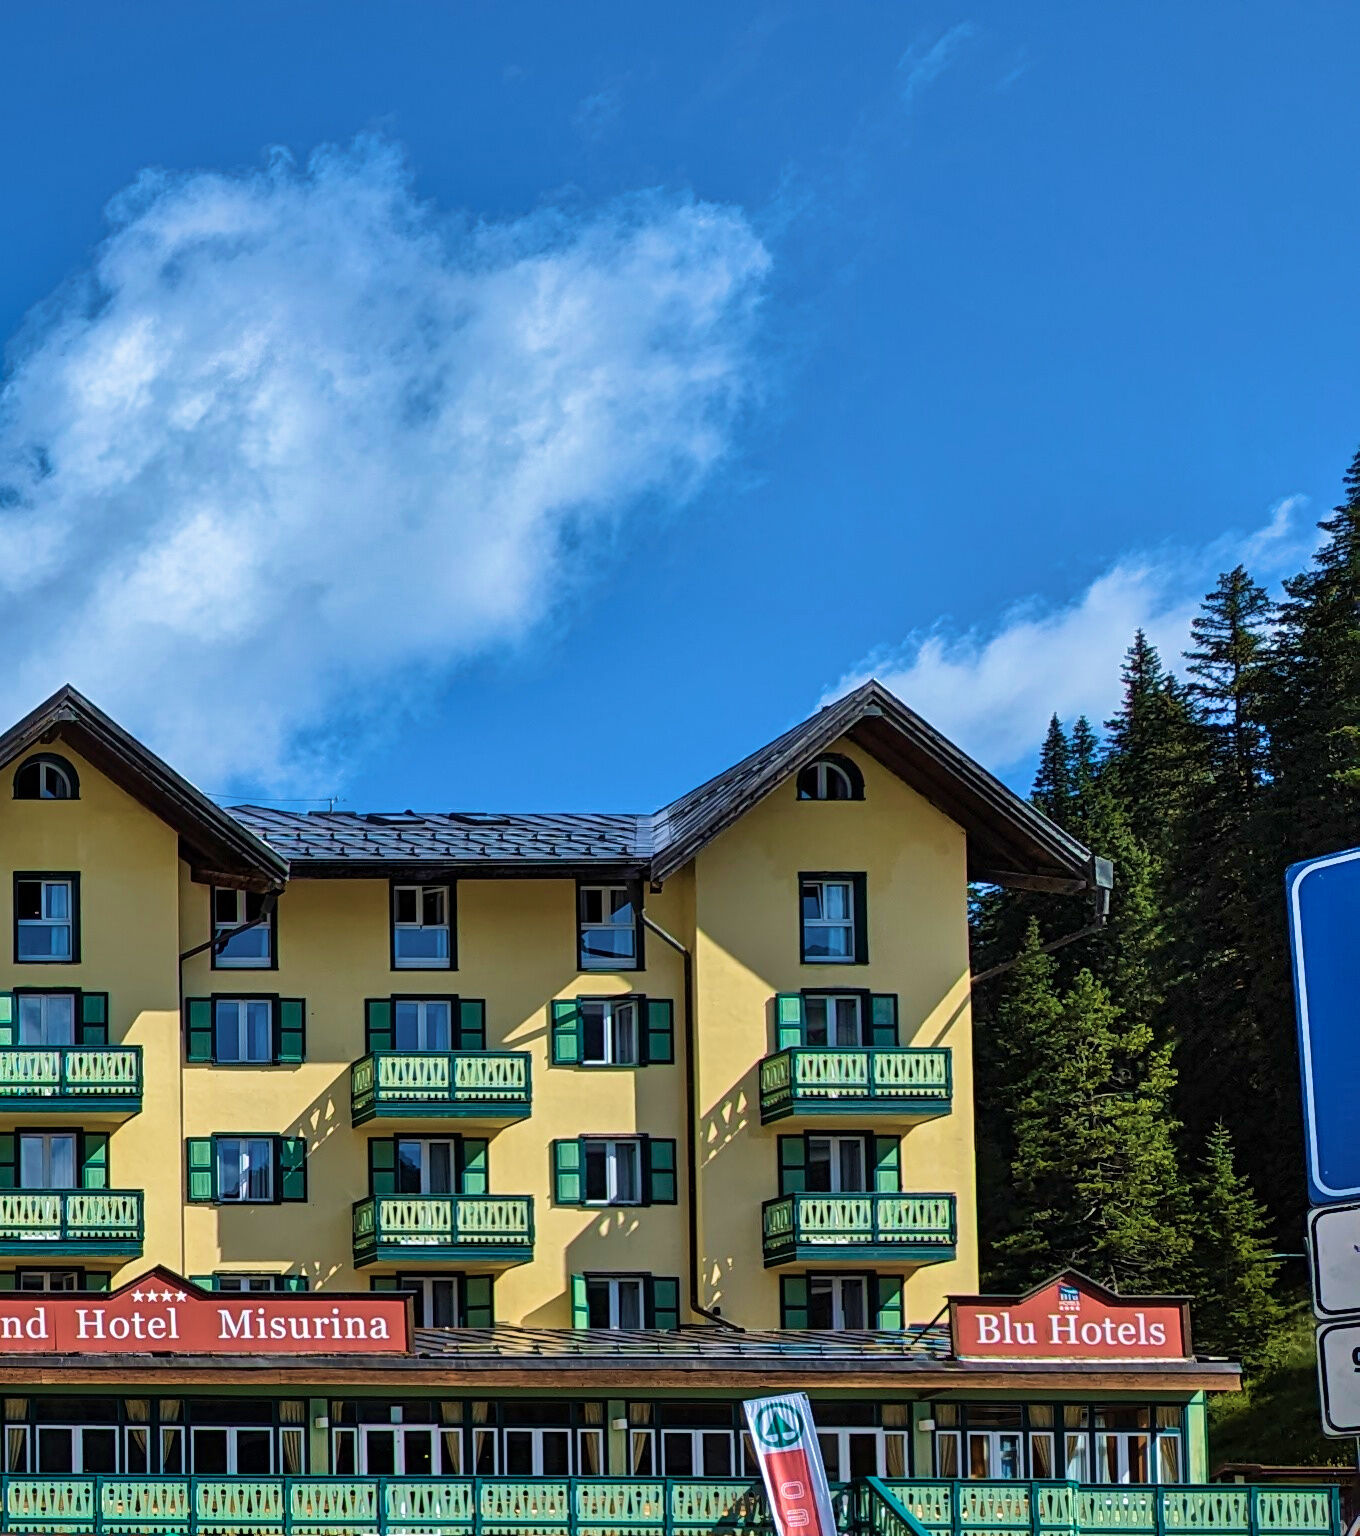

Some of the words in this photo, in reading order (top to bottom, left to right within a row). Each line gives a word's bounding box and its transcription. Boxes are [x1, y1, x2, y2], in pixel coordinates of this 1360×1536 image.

[75, 1307, 180, 1340] Hotel
[217, 1307, 390, 1340] Misurina
[975, 1311, 1037, 1344] Blu
[1048, 1312, 1167, 1346] Hotels
